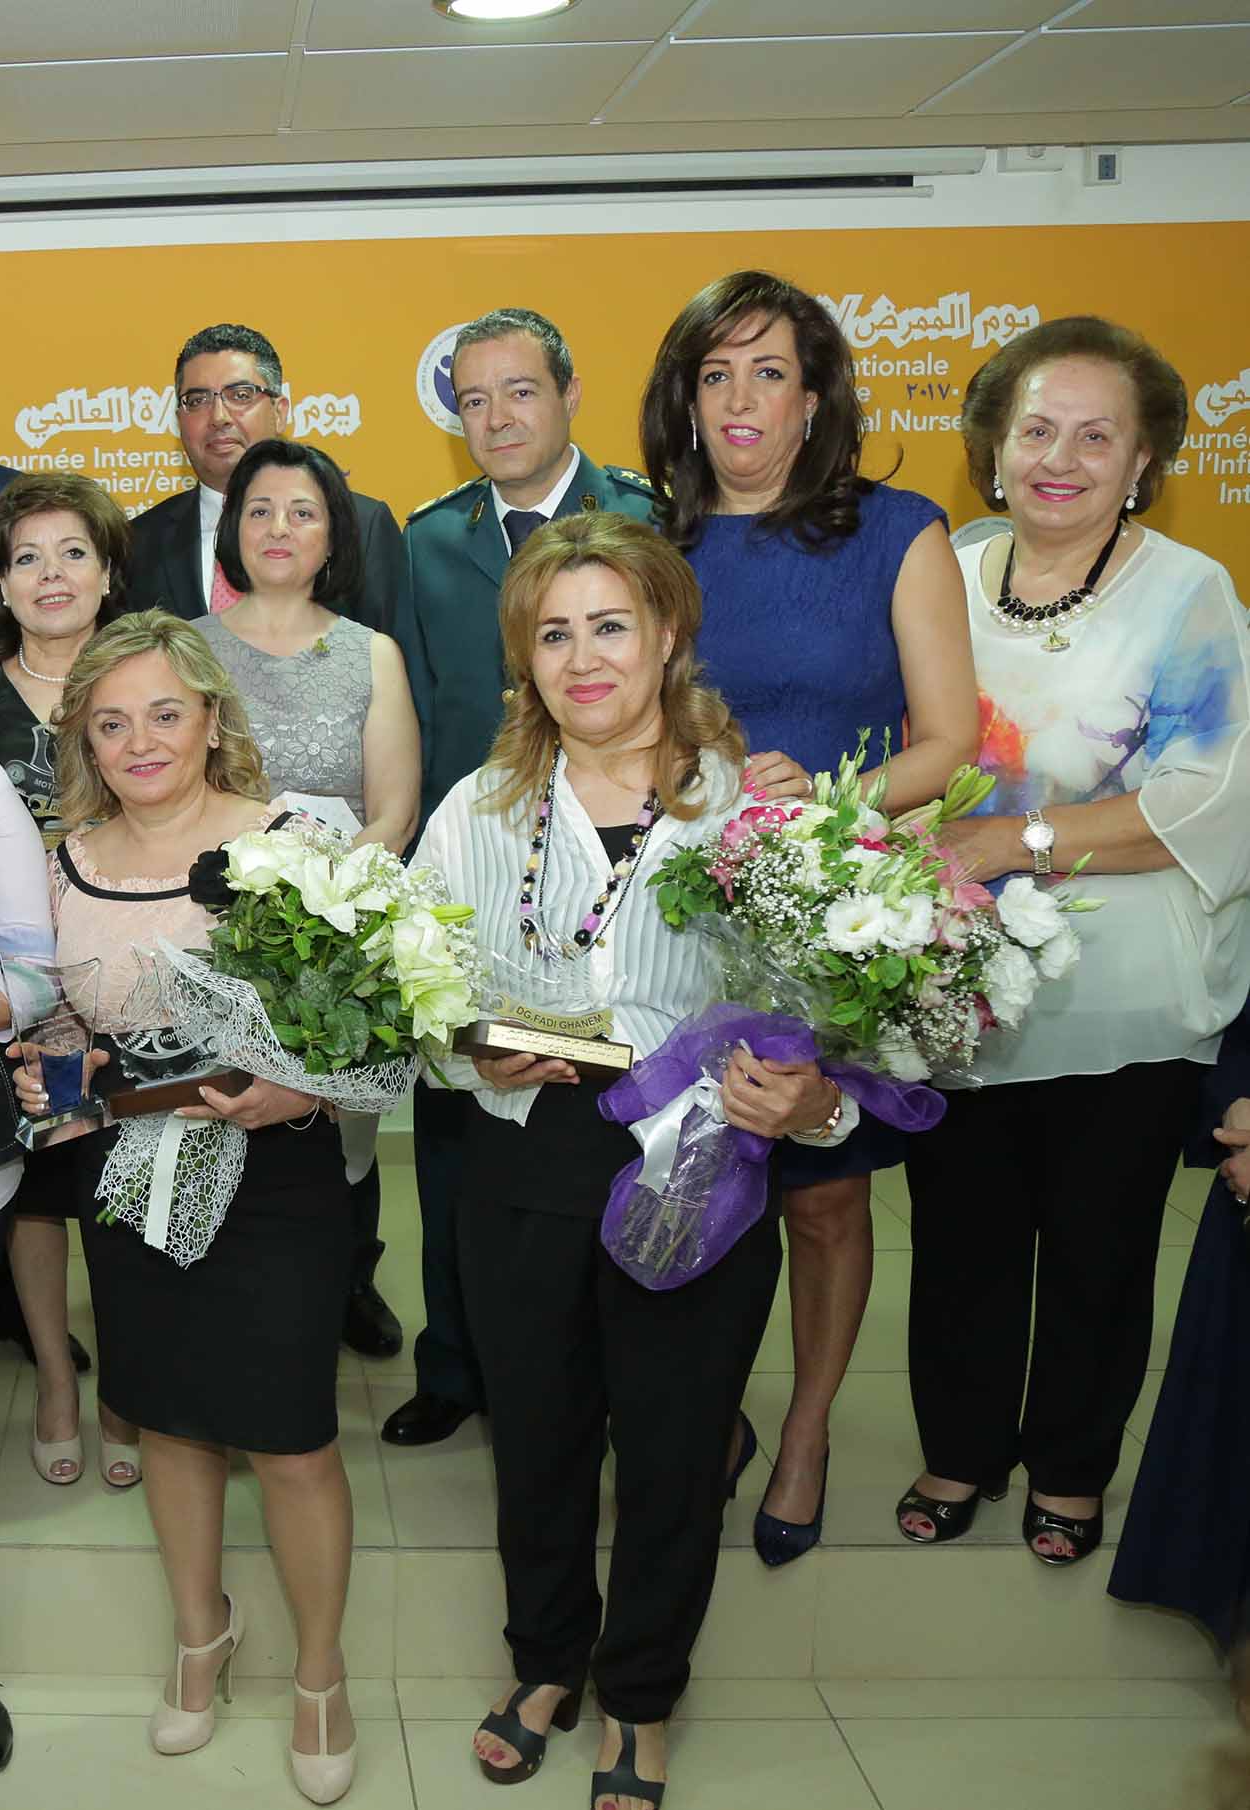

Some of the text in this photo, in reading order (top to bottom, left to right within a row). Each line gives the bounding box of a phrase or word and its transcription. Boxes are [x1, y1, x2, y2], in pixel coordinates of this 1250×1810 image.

[834, 296, 967, 344] الممرض/
[851, 351, 950, 377] ationale
[21, 393, 126, 443] العالمي
[298, 397, 355, 432] يوم
[890, 408, 962, 432] Nurse
[93, 446, 192, 468] Interna
[93, 469, 195, 494] mier/ère
[558, 1014, 604, 1030] GHANEM
